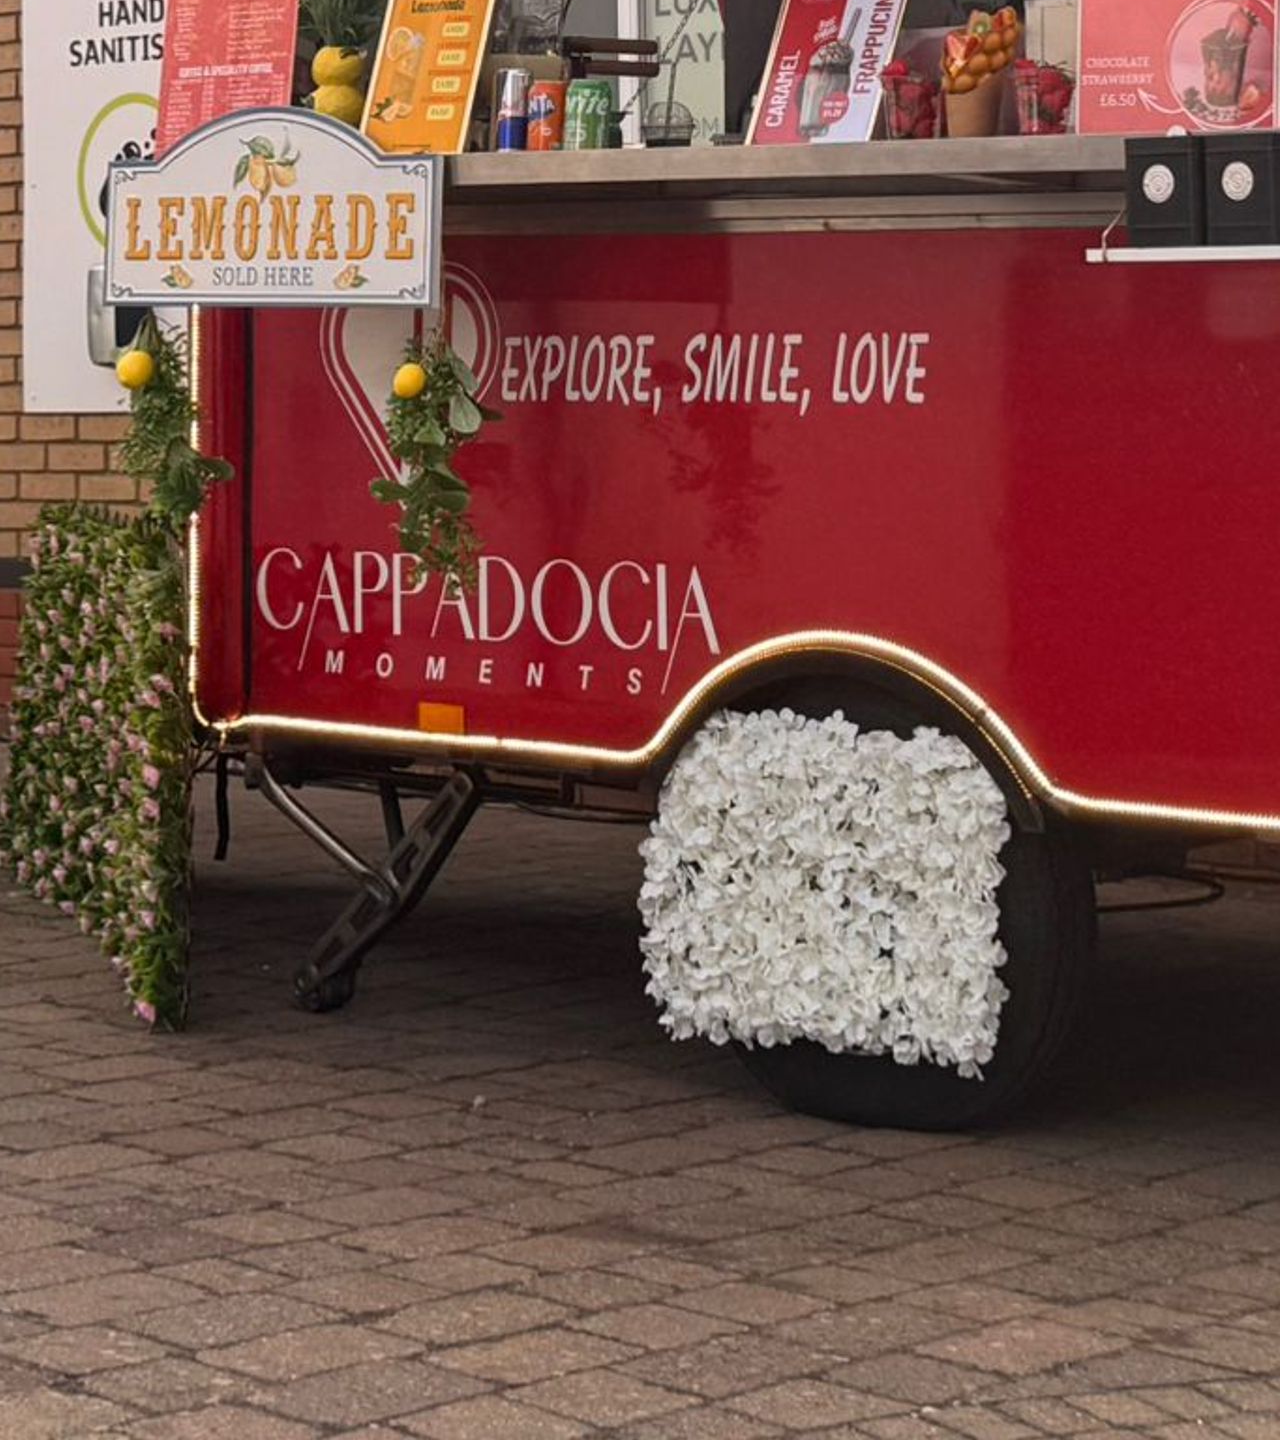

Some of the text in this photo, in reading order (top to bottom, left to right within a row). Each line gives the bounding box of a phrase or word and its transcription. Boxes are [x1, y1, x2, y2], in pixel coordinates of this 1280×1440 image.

[656, 32, 725, 64] LAY
[765, 49, 801, 128] CARAMEL
[1100, 92, 1137, 107] £6.50
[124, 192, 416, 261] LEMONADE
[212, 265, 314, 287] SOLD HERE
[501, 332, 930, 416] EXPLORE, SMILE, LOVE
[256, 547, 720, 694] CAPPADOCIA
[324, 649, 642, 695] MOMENTS
